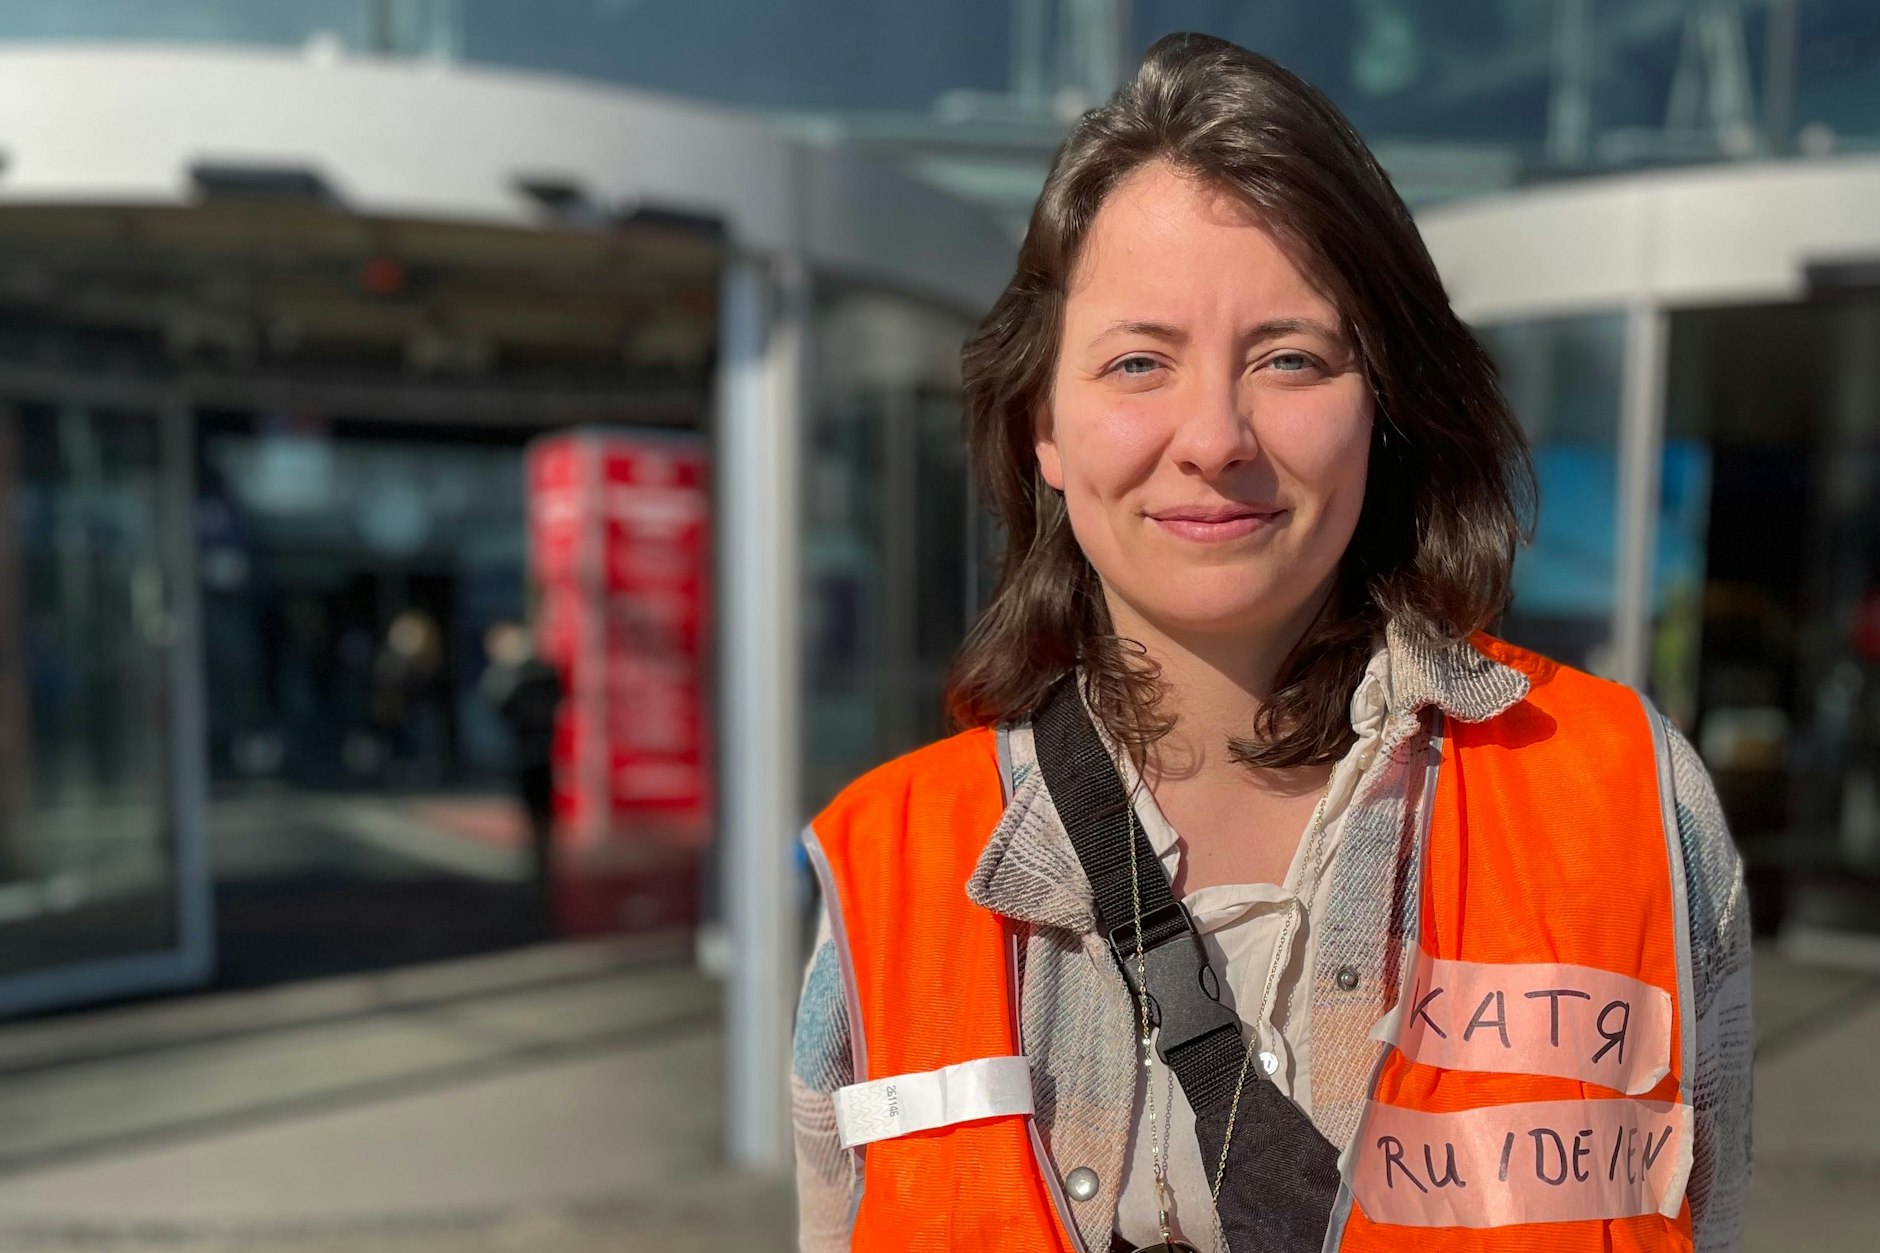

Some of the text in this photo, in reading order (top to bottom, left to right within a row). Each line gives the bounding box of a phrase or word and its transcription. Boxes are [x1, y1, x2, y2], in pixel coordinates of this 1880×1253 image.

[1409, 978, 1630, 1064] КАТЯ
[886, 1085, 899, 1117] 261146
[1376, 1135, 1467, 1193] RU
